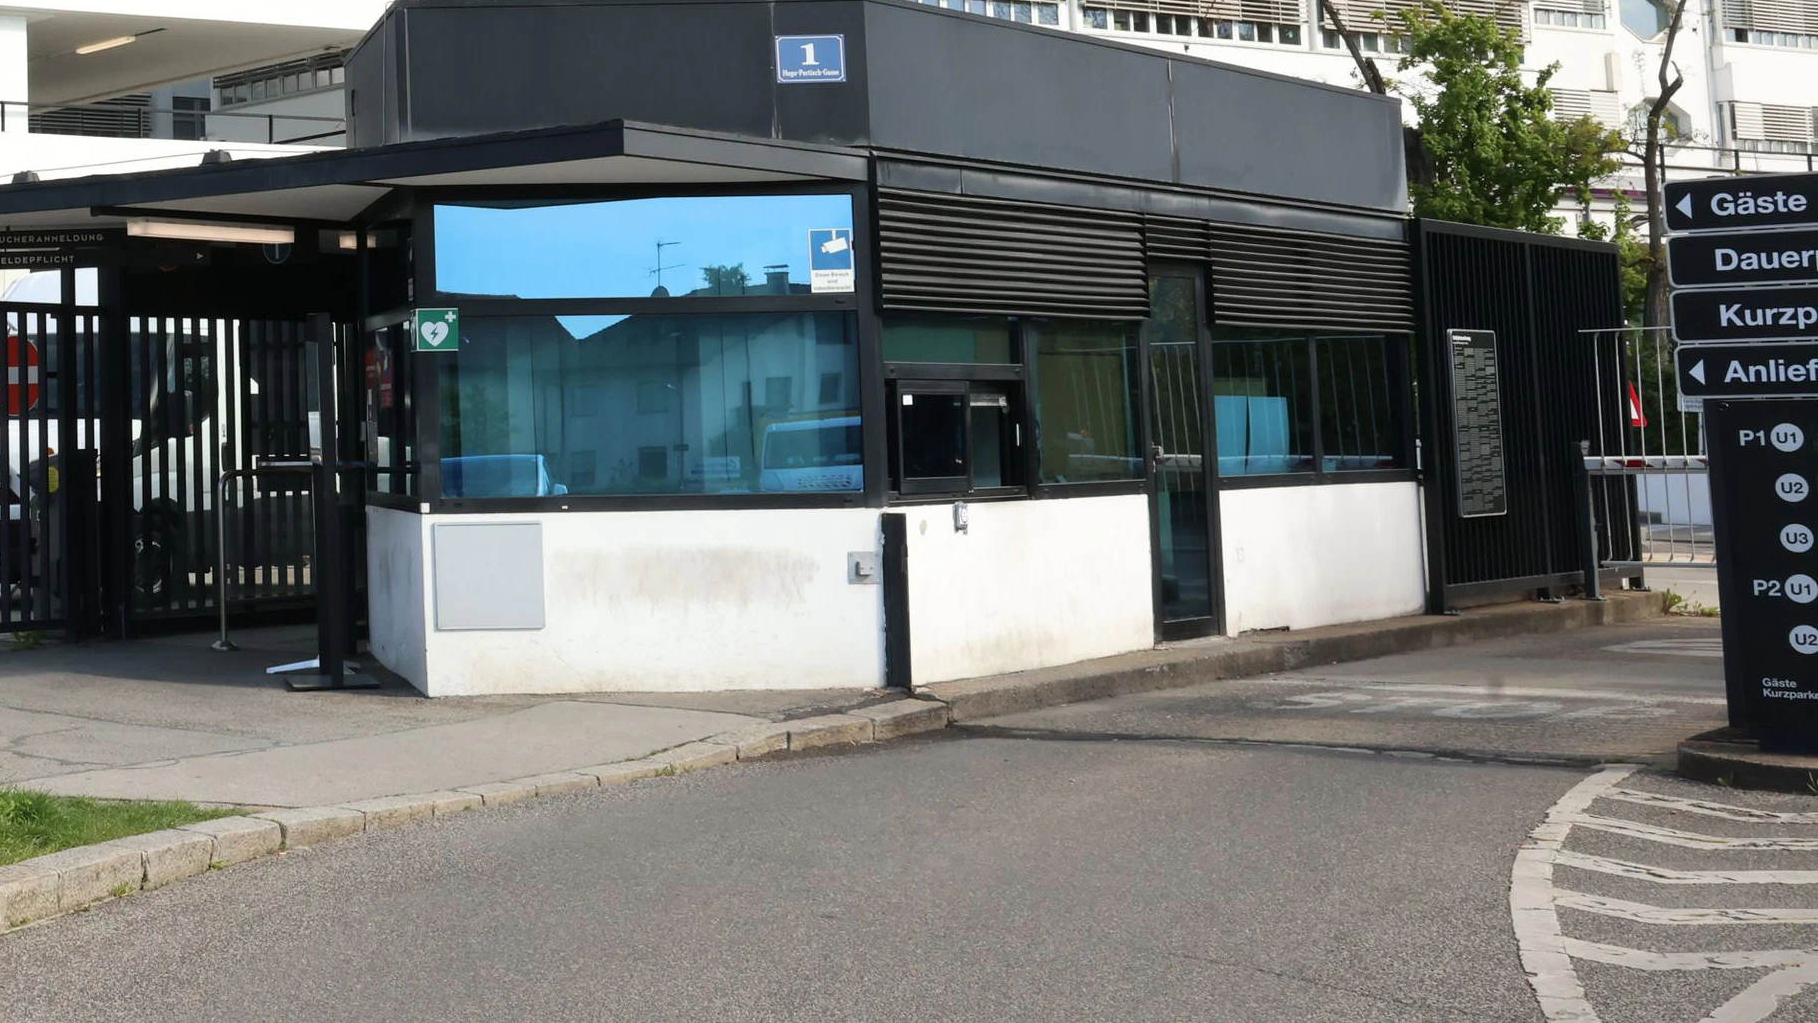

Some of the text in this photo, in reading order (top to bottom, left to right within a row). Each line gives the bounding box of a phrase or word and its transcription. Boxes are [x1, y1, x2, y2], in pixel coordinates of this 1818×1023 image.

[800, 42, 820, 65] 1
[1710, 191, 1807, 216] Gäste
[1714, 248, 1818, 272] Dauer
[1719, 303, 1818, 330] Kurzp
[1724, 358, 1818, 383] Anlief
[1739, 430, 1797, 447] P1 U1
[1781, 482, 1804, 494] U2
[1786, 532, 1809, 545] U3
[1753, 579, 1811, 596] P2 U1
[1795, 633, 1818, 646] U2
[1762, 677, 1798, 688] Gäste
